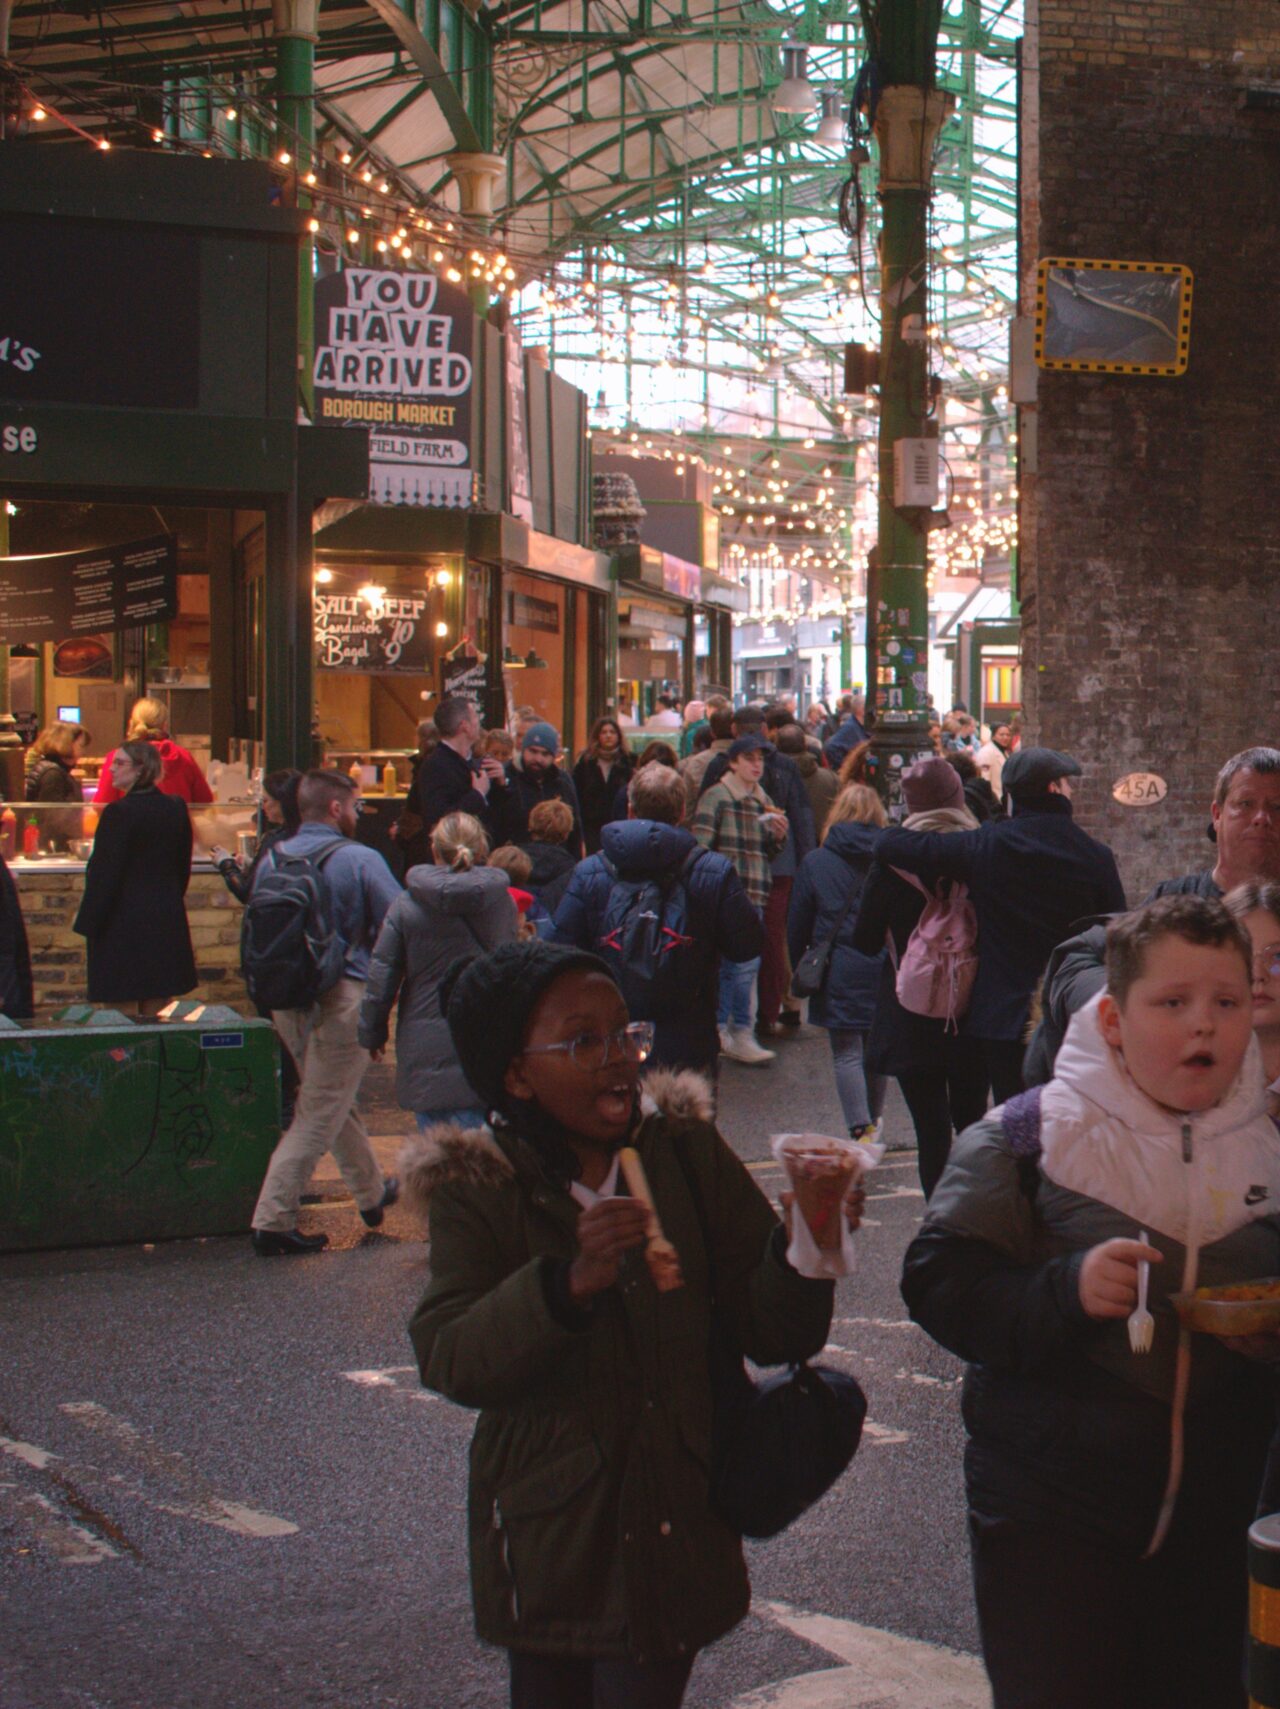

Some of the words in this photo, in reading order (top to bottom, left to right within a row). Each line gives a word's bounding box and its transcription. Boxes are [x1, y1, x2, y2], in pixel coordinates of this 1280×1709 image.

[349, 272, 433, 311] YOU
[333, 311, 448, 350] HAVE
[316, 350, 468, 390] ARRIVED
[323, 398, 393, 422] BOROUGH
[397, 402, 456, 427] MARKET
[414, 442, 454, 459] FARM
[314, 595, 361, 616] SALT
[366, 596, 426, 621] BEEF
[322, 635, 370, 666] Bagel
[1121, 780, 1159, 799] 45A
